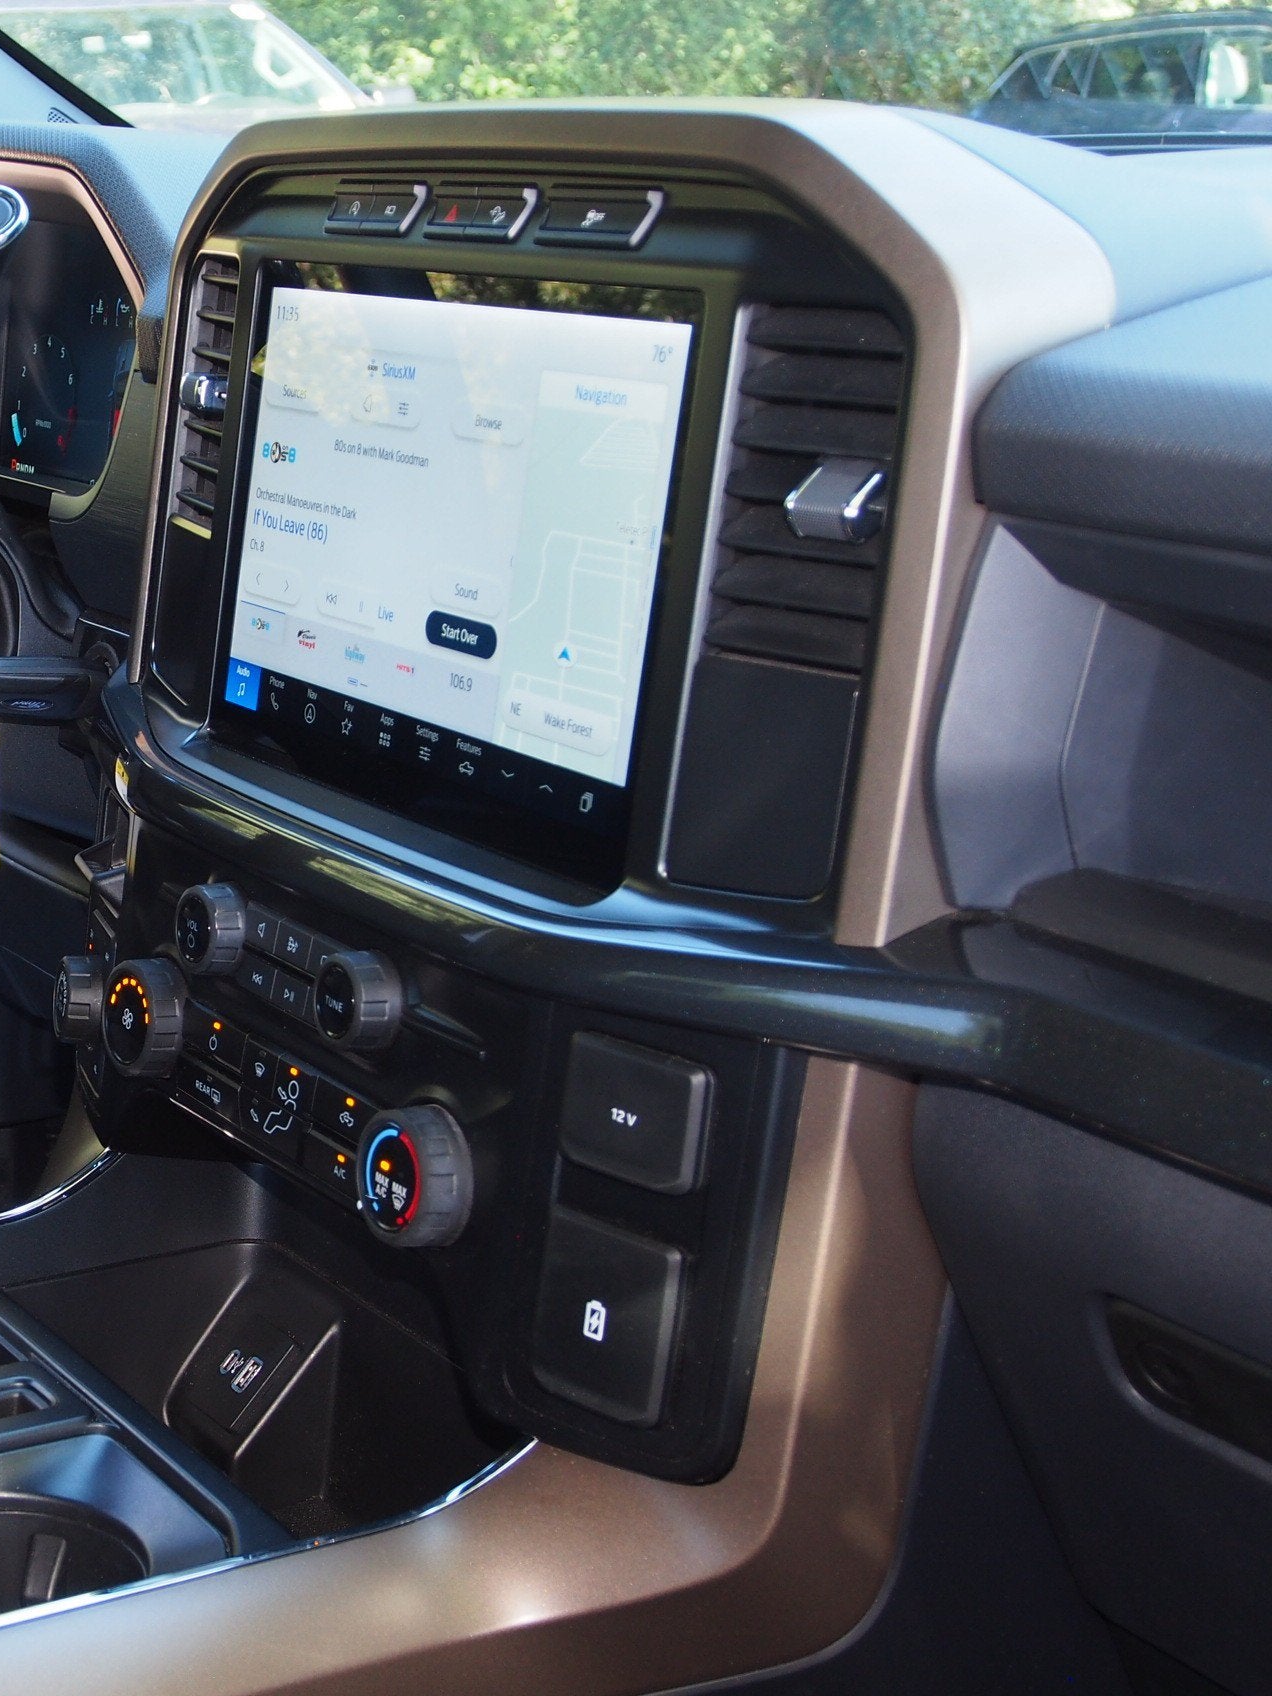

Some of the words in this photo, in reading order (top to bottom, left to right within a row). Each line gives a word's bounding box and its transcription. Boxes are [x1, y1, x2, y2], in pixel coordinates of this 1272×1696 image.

[277, 305, 299, 322] 11:35
[32, 343, 37, 355] 3
[47, 336, 52, 348] 4
[60, 347, 65, 359] 5
[21, 365, 27, 378] 2
[68, 373, 74, 386] 6
[382, 362, 416, 381] SiriusXM
[281, 384, 308, 400] Sources
[574, 384, 628, 406] Navigation
[475, 414, 503, 430] Browse
[334, 439, 346, 453] 80s
[347, 444, 357, 454] on
[357, 443, 362, 455] 8
[362, 444, 377, 457] with
[378, 446, 395, 461] Mark
[396, 450, 429, 467] Goodman
[256, 487, 286, 502] Orchestral
[287, 494, 322, 513] Manoeuvres
[330, 505, 341, 517] the
[342, 506, 358, 520] Dark
[253, 508, 261, 525] If
[262, 511, 278, 530] You
[279, 515, 305, 536] Leave
[307, 520, 328, 545] (86)
[260, 540, 265, 552] 8
[455, 583, 478, 601] Sound
[378, 606, 394, 622] Live
[441, 623, 460, 641] Start
[460, 628, 479, 645] Over
[236, 665, 251, 679] Audio
[269, 675, 285, 690] Phone
[450, 672, 473, 692] 106.9
[307, 688, 318, 700] Nav
[344, 700, 354, 713] Fav
[510, 702, 522, 717] NE
[380, 713, 395, 727] Apps
[544, 712, 565, 730] Wake
[566, 719, 593, 738] Forest
[416, 725, 439, 743] Settings
[456, 738, 482, 756] Features
[325, 994, 344, 1013] TUNE
[195, 1080, 211, 1096] REAR
[333, 1165, 346, 1180] A/C
[375, 1171, 390, 1189] MAX
[375, 1184, 388, 1199] A/C
[391, 1181, 407, 1199] MAX
